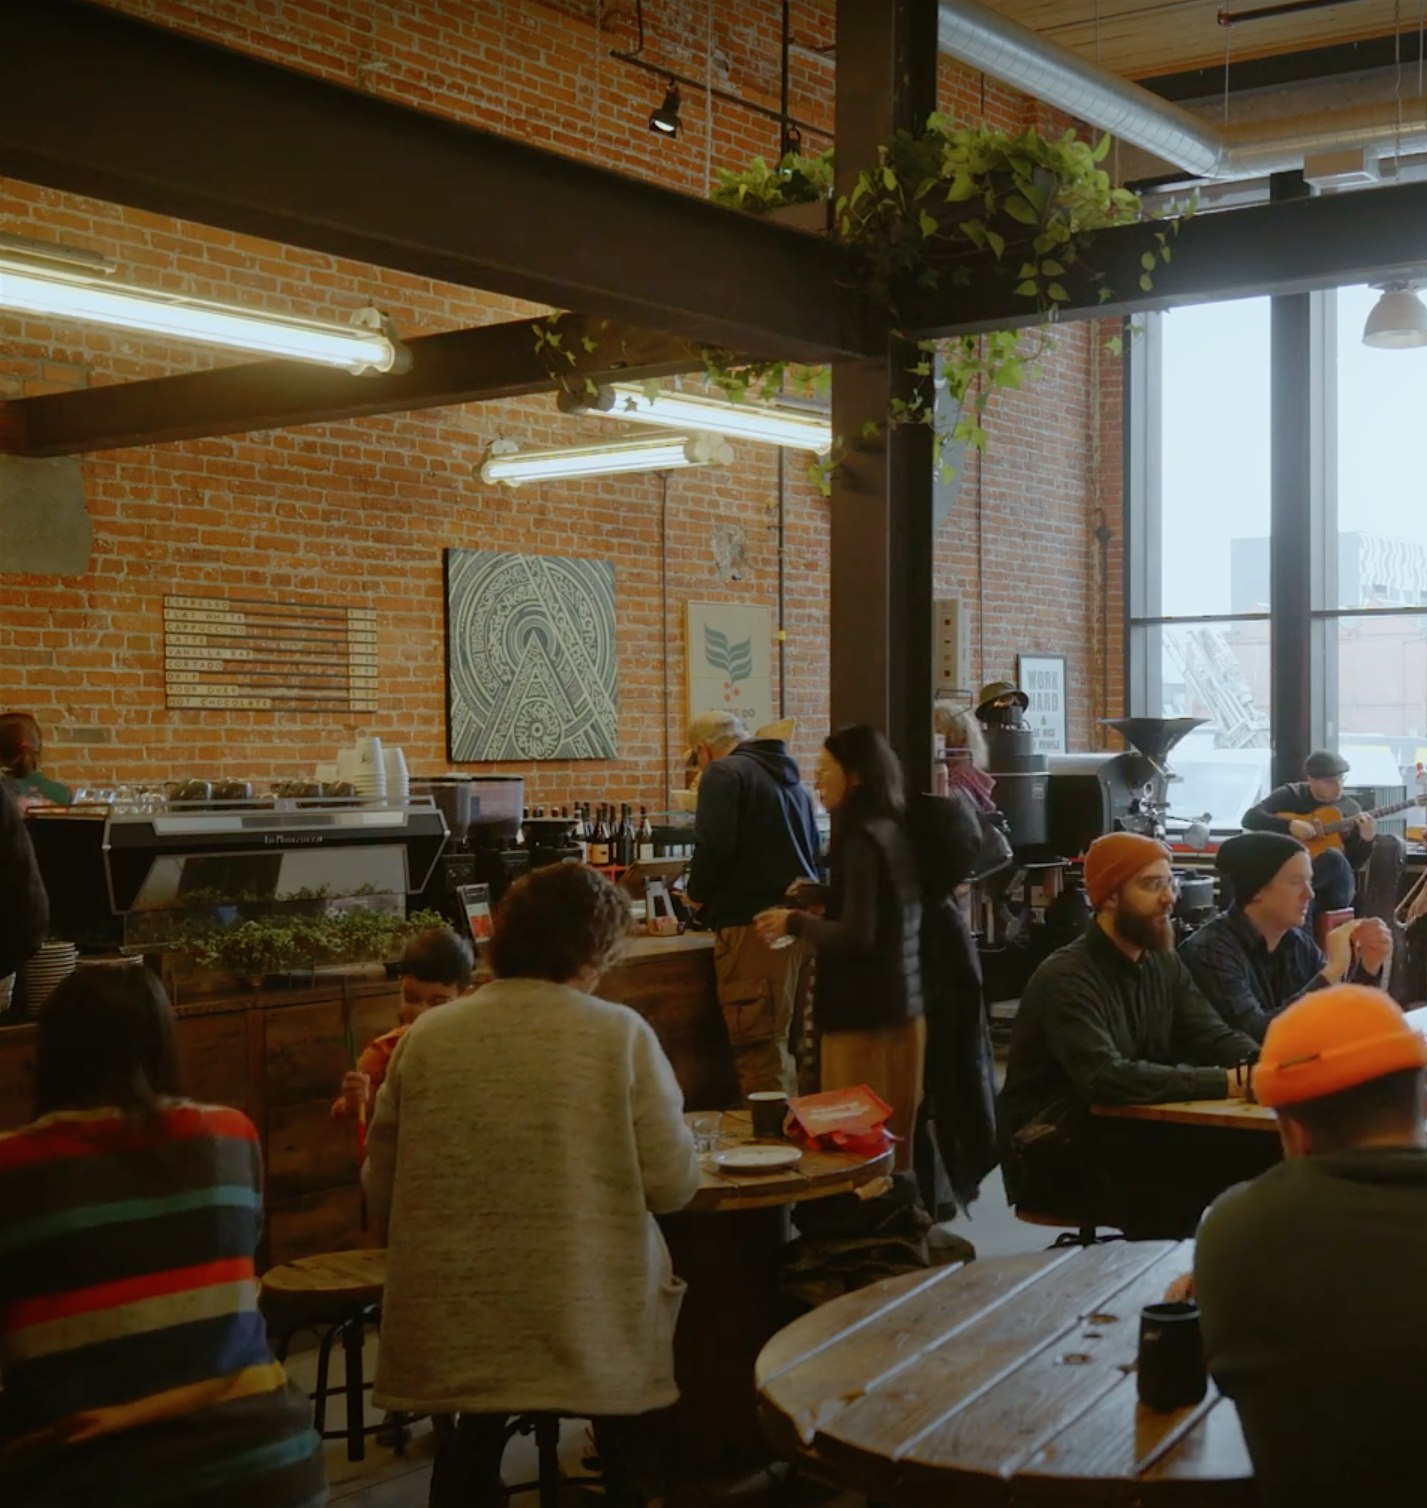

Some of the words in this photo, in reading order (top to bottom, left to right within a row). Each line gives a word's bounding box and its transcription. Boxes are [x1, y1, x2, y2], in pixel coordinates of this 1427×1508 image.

[166, 598, 228, 608] ESPRESSO
[166, 610, 195, 619] FLAT
[206, 612, 242, 621] WHITE
[167, 622, 245, 633] CAPPUCCINO
[167, 635, 204, 644] LATTE
[168, 648, 221, 656] VANILLA
[167, 660, 222, 669] CORTADO
[168, 672, 198, 681] DRIP
[1027, 670, 1058, 690] WORK
[168, 685, 197, 693] POUR
[207, 686, 236, 694] OVER
[169, 697, 190, 705] HOT
[200, 697, 269, 707] CHOCOLATE
[1029, 692, 1058, 712] HARD
